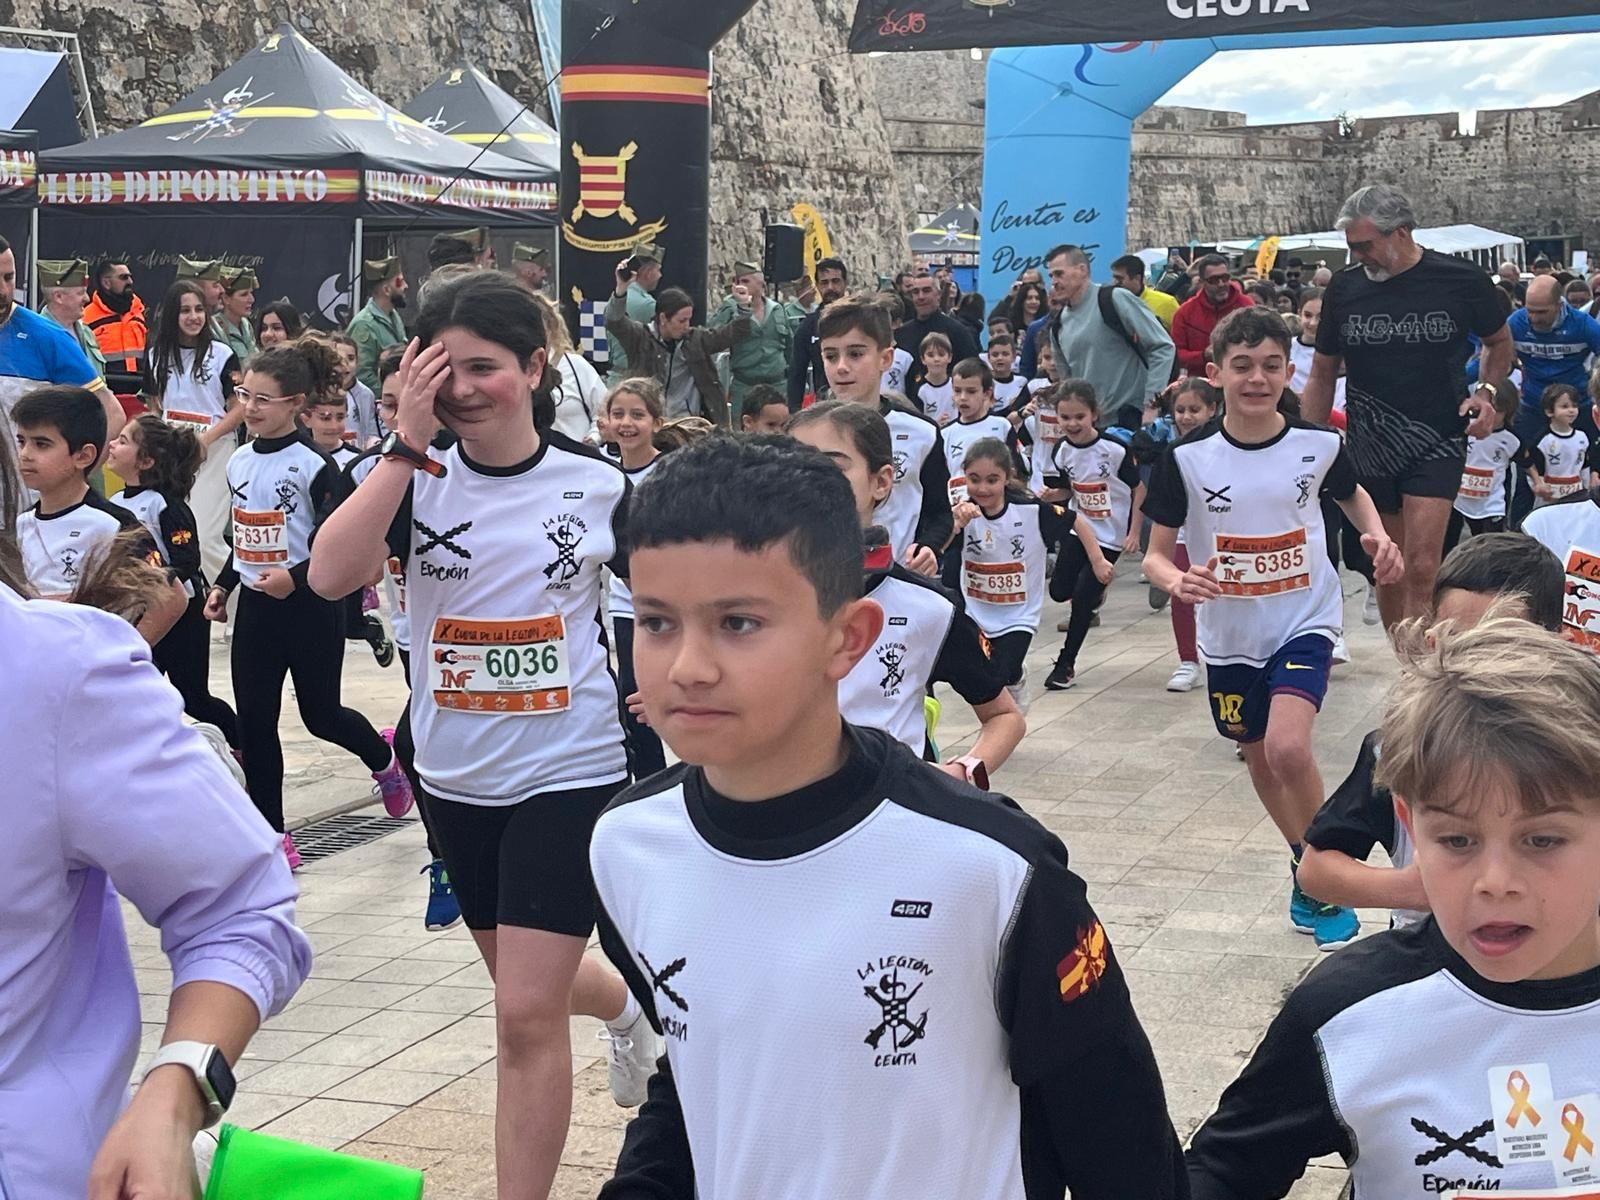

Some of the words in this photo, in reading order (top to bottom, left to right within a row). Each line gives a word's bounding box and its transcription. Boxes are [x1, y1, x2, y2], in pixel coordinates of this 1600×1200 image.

[39, 172, 112, 204] LUB
[123, 169, 328, 203] DEPORTIVO
[991, 200, 1067, 232] Ceuta
[1073, 208, 1100, 223] es
[1468, 475, 1491, 488] 6242
[244, 527, 281, 544] 6317
[1255, 548, 1304, 574] 6385
[988, 574, 1022, 589] 6383
[486, 644, 559, 678] 6036
[857, 962, 875, 980] LA
[874, 1052, 917, 1068] CEUTA
